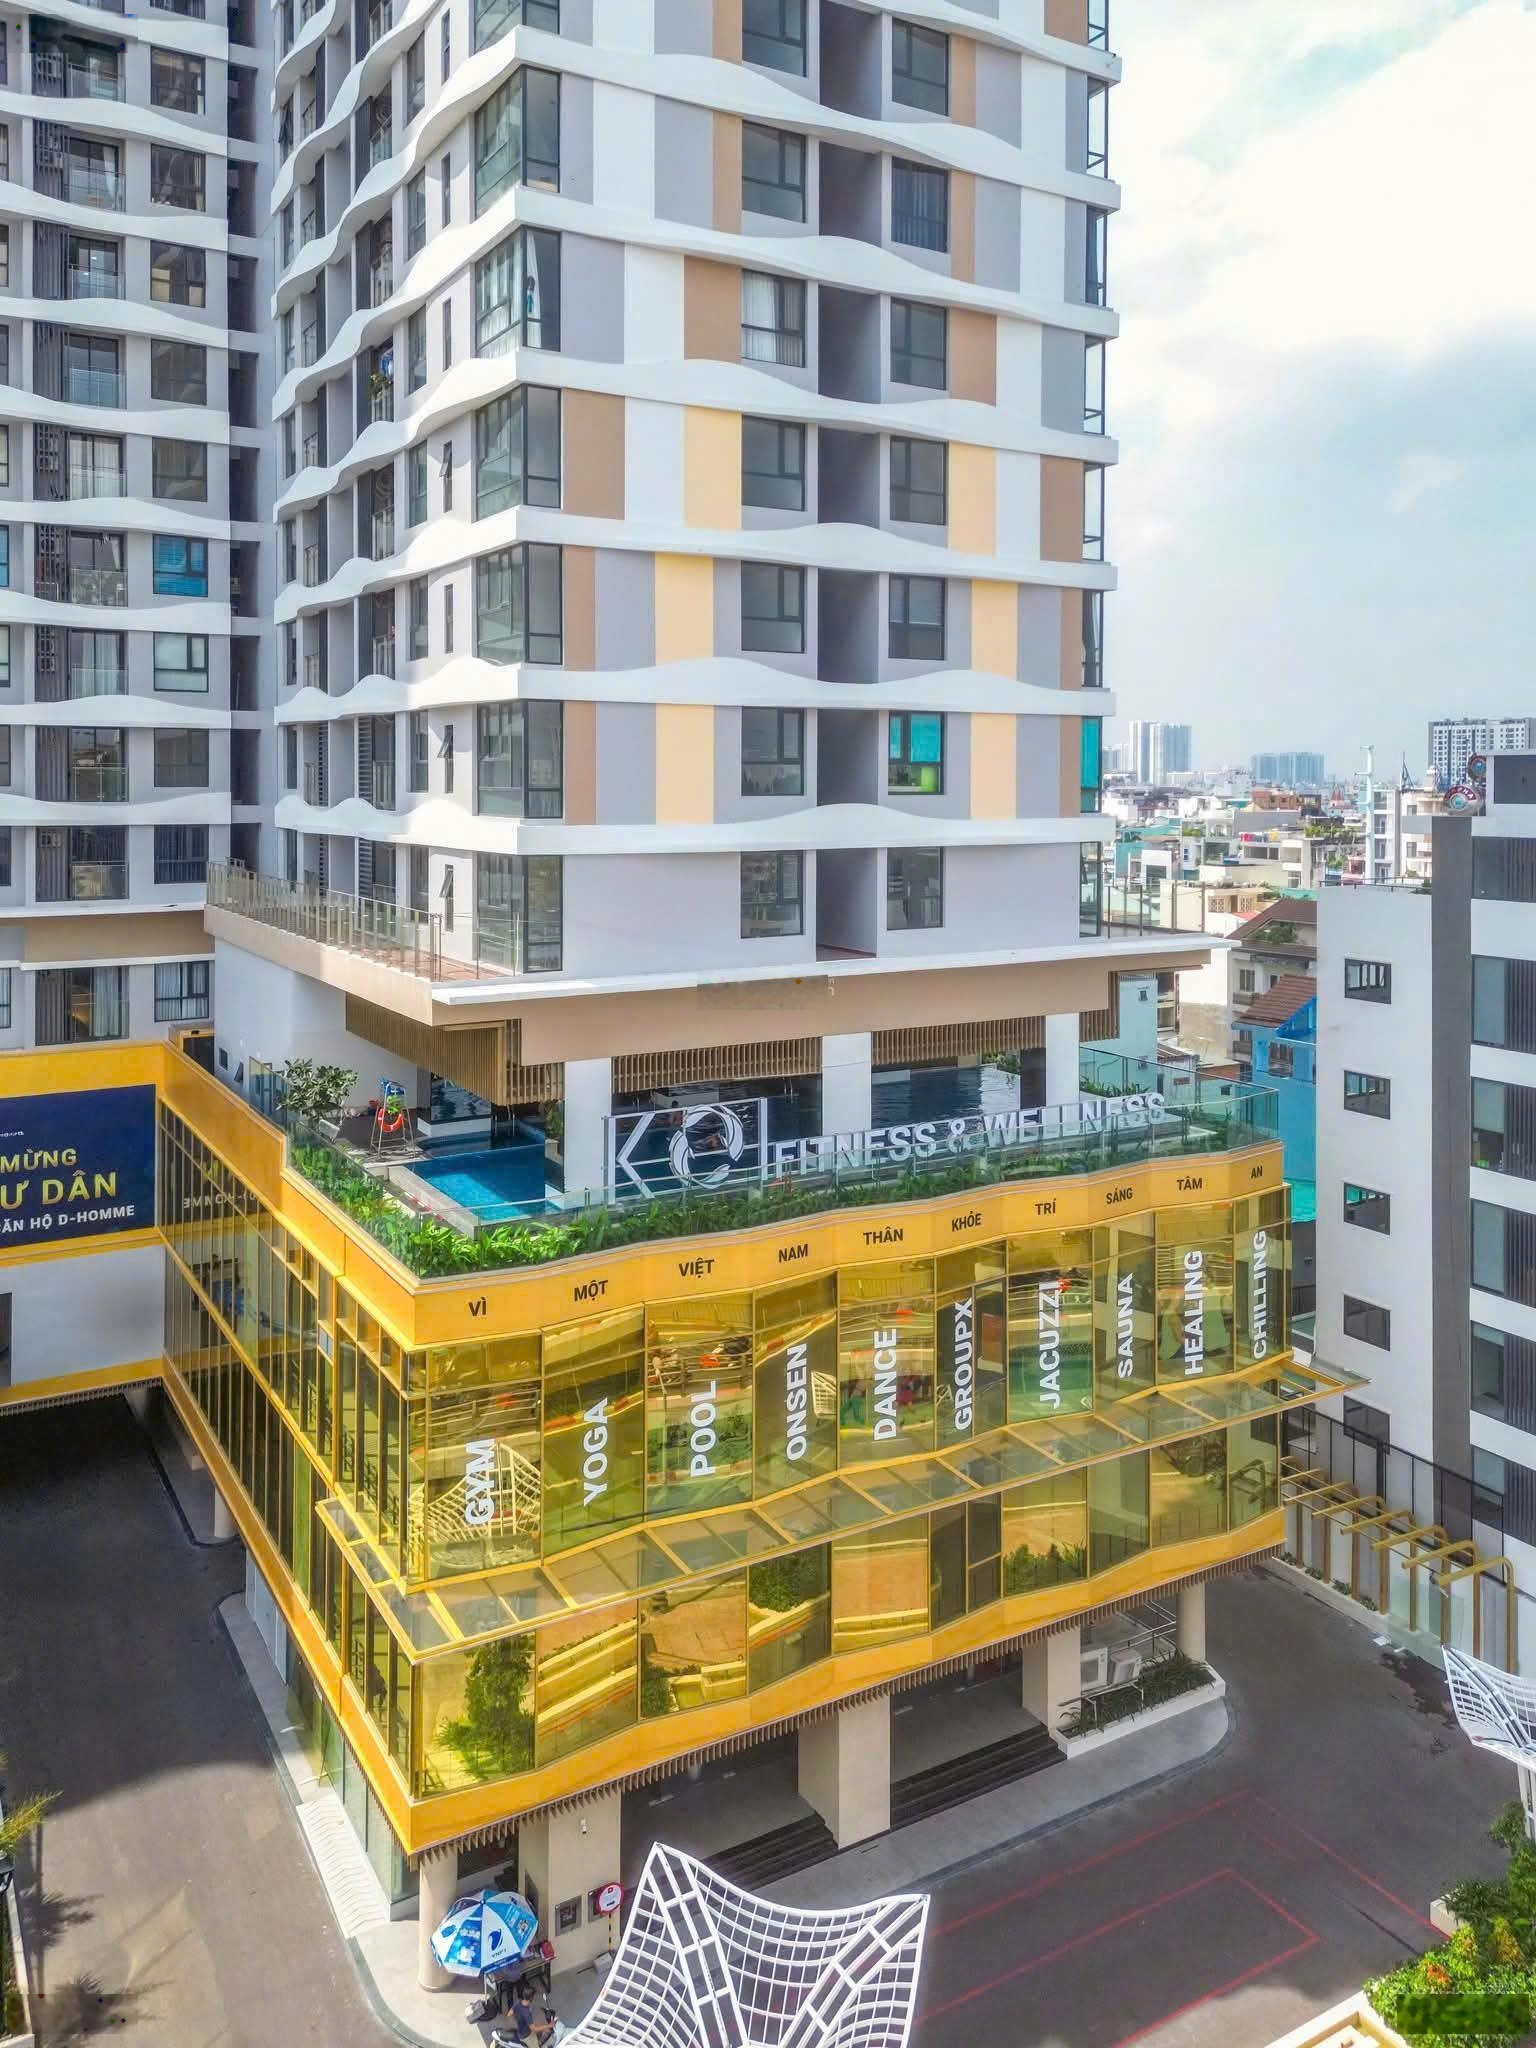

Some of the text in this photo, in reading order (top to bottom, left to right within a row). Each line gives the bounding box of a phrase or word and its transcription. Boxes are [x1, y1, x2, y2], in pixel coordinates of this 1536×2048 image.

[0, 1148, 77, 1173] MỪNG
[42, 1169, 117, 1205] DÂN
[775, 1123, 937, 1179] FITNESS
[948, 1120, 967, 1153] &
[984, 1092, 1165, 1148] WELLNESS
[0, 1205, 135, 1233] ĂN HỘ D-HOMME
[468, 1165, 1263, 1317] VÌ MỘT VIỆT NAM THÂN KHỎE TRÍ SÁNG TÂM AN
[1039, 1281, 1061, 1409] JACUZZI
[1117, 1272, 1134, 1379] SAUNA
[1184, 1250, 1204, 1375] HEALING
[1253, 1230, 1267, 1360] CHILLING
[786, 1343, 808, 1462] ONSEN
[873, 1328, 897, 1441] DANCE
[954, 1296, 973, 1431] GROUPX
[465, 1438, 496, 1525] GYM
[583, 1397, 608, 1506] YOGA
[690, 1380, 717, 1478] POOL
